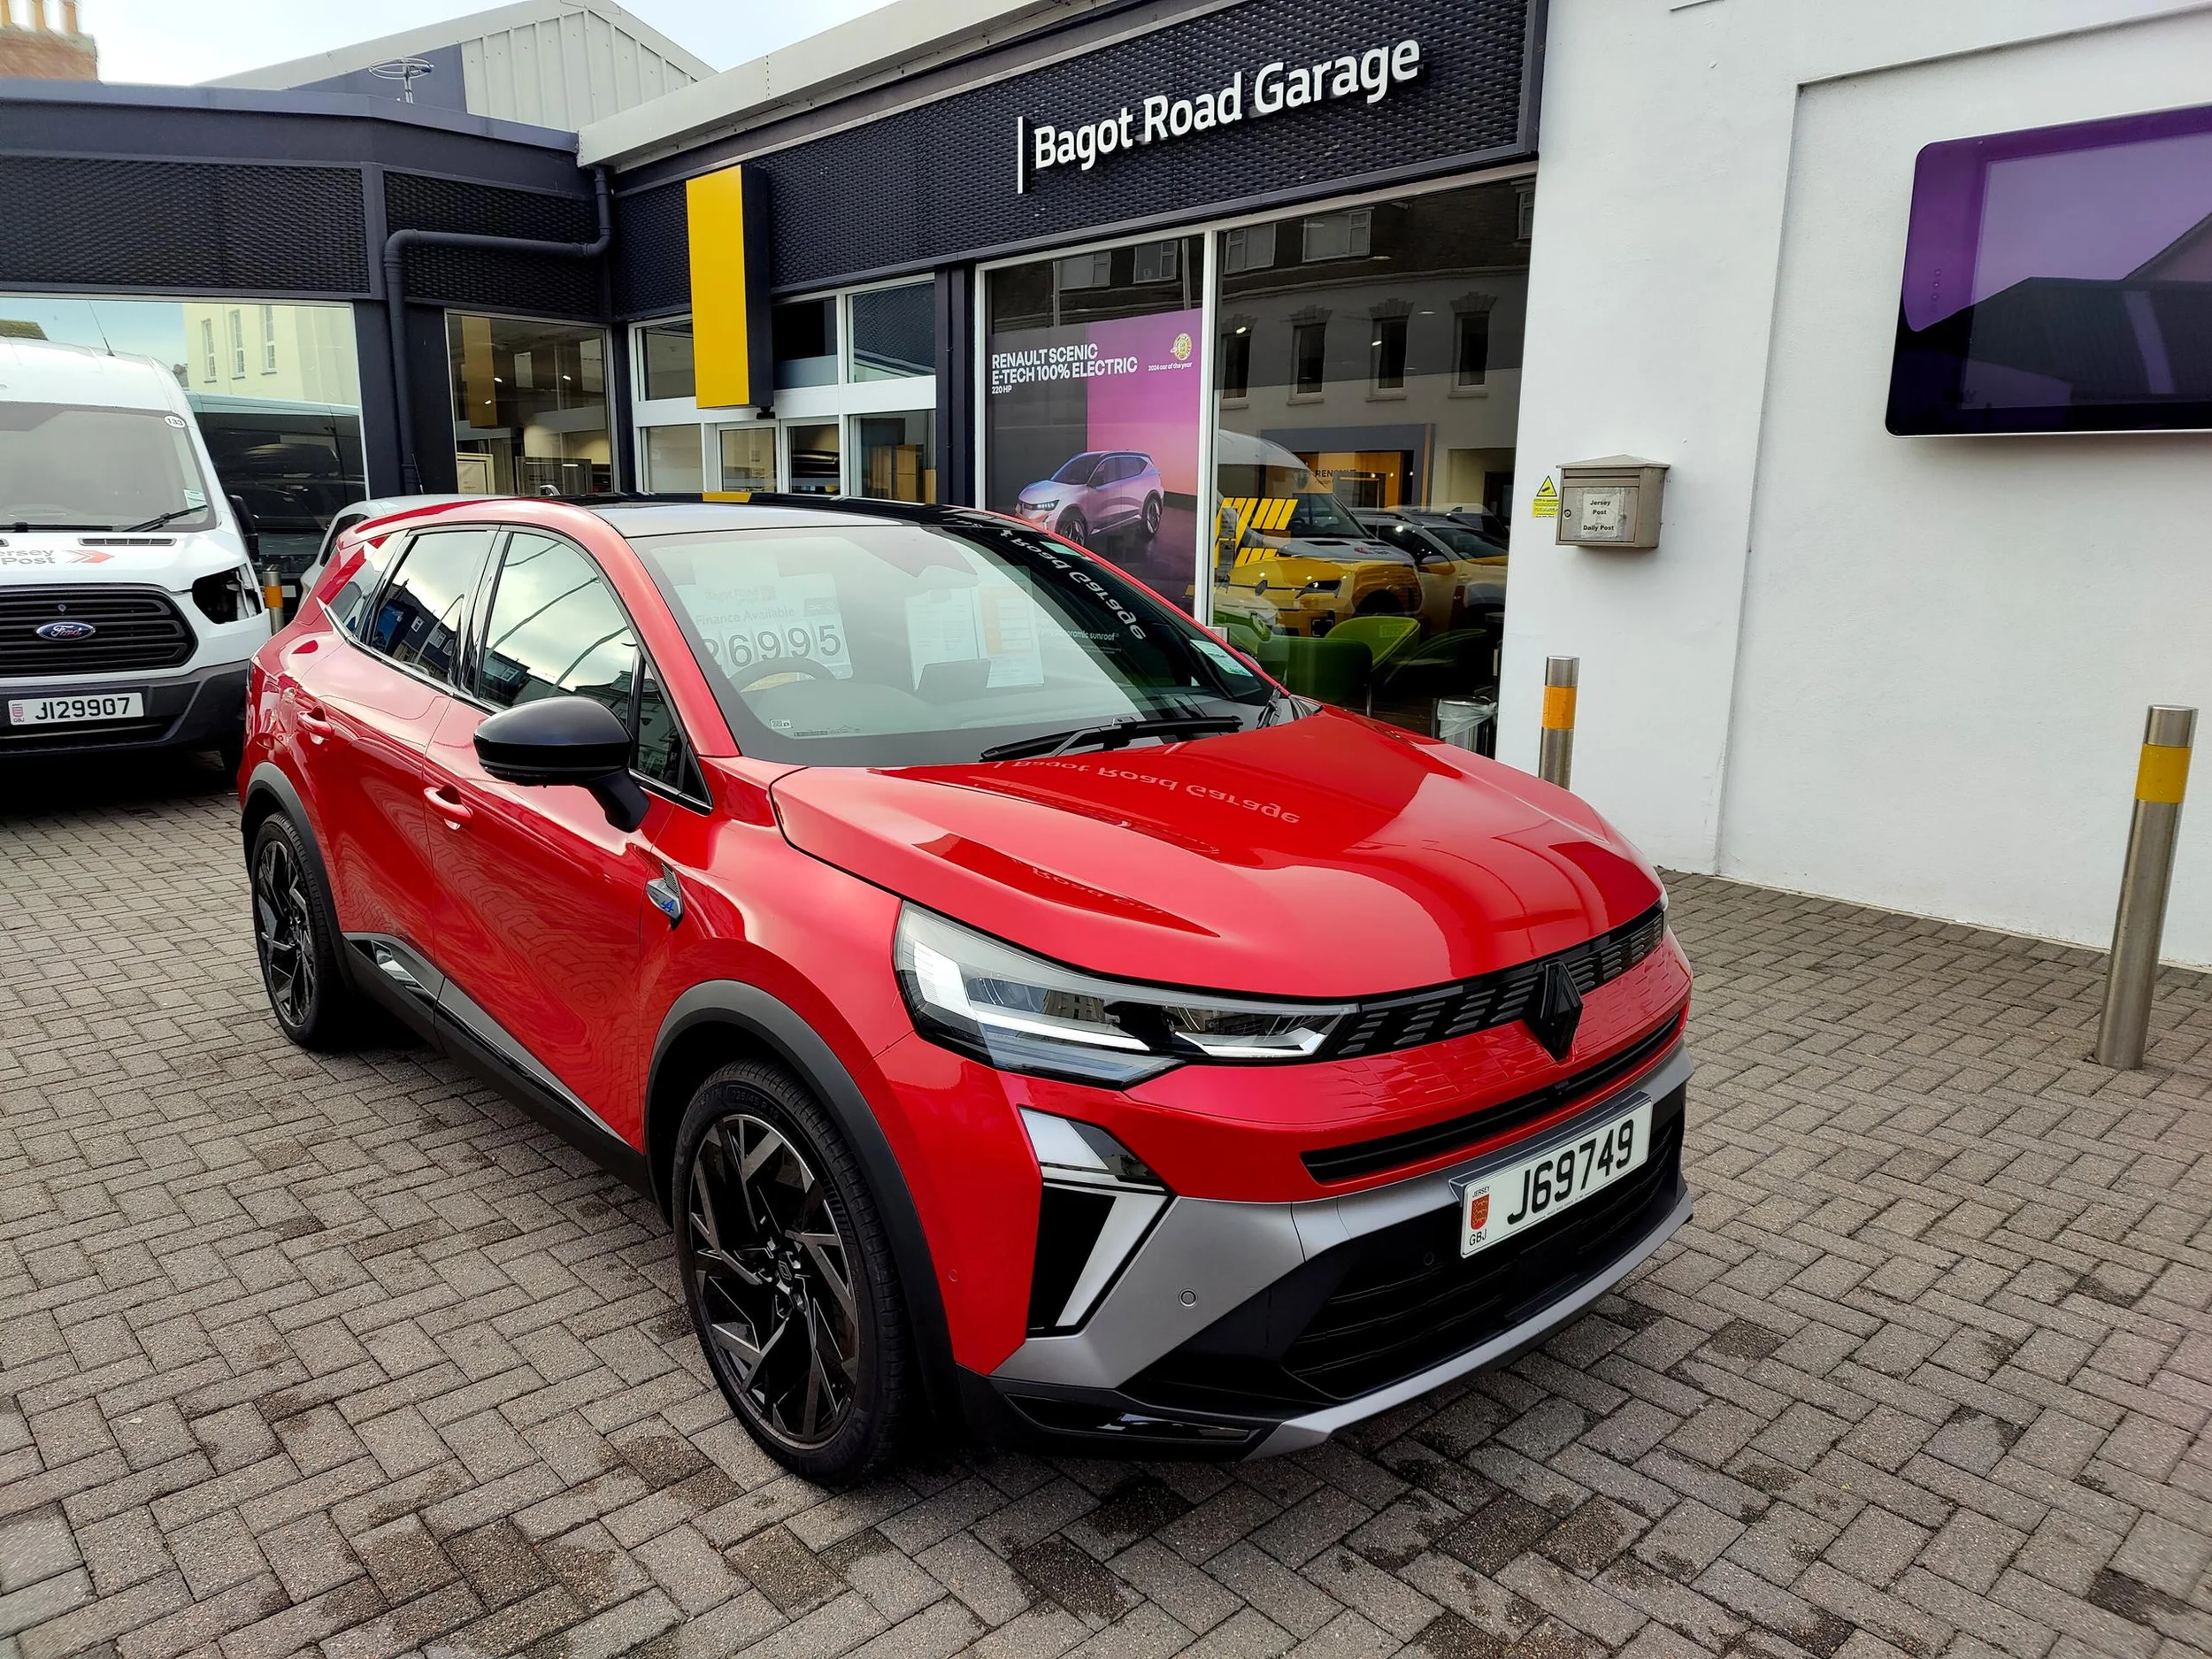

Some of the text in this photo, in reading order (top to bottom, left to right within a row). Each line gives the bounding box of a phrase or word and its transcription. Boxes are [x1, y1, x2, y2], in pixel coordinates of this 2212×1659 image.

[1034, 39, 1421, 171] Bagot Road Garage
[991, 342, 1098, 370] RENAULT SCENIC
[991, 357, 1138, 386] E-TECH 100% ELECTRIC
[1, 557, 56, 565] Post
[695, 612, 741, 626] Finance
[743, 606, 795, 622] Available
[50, 624, 84, 640] Ford
[35, 696, 131, 721] J129907
[1506, 1118, 1635, 1225] J69749
[1472, 1185, 1491, 1199] JERSEY
[1469, 1230, 1487, 1247] GBJ
